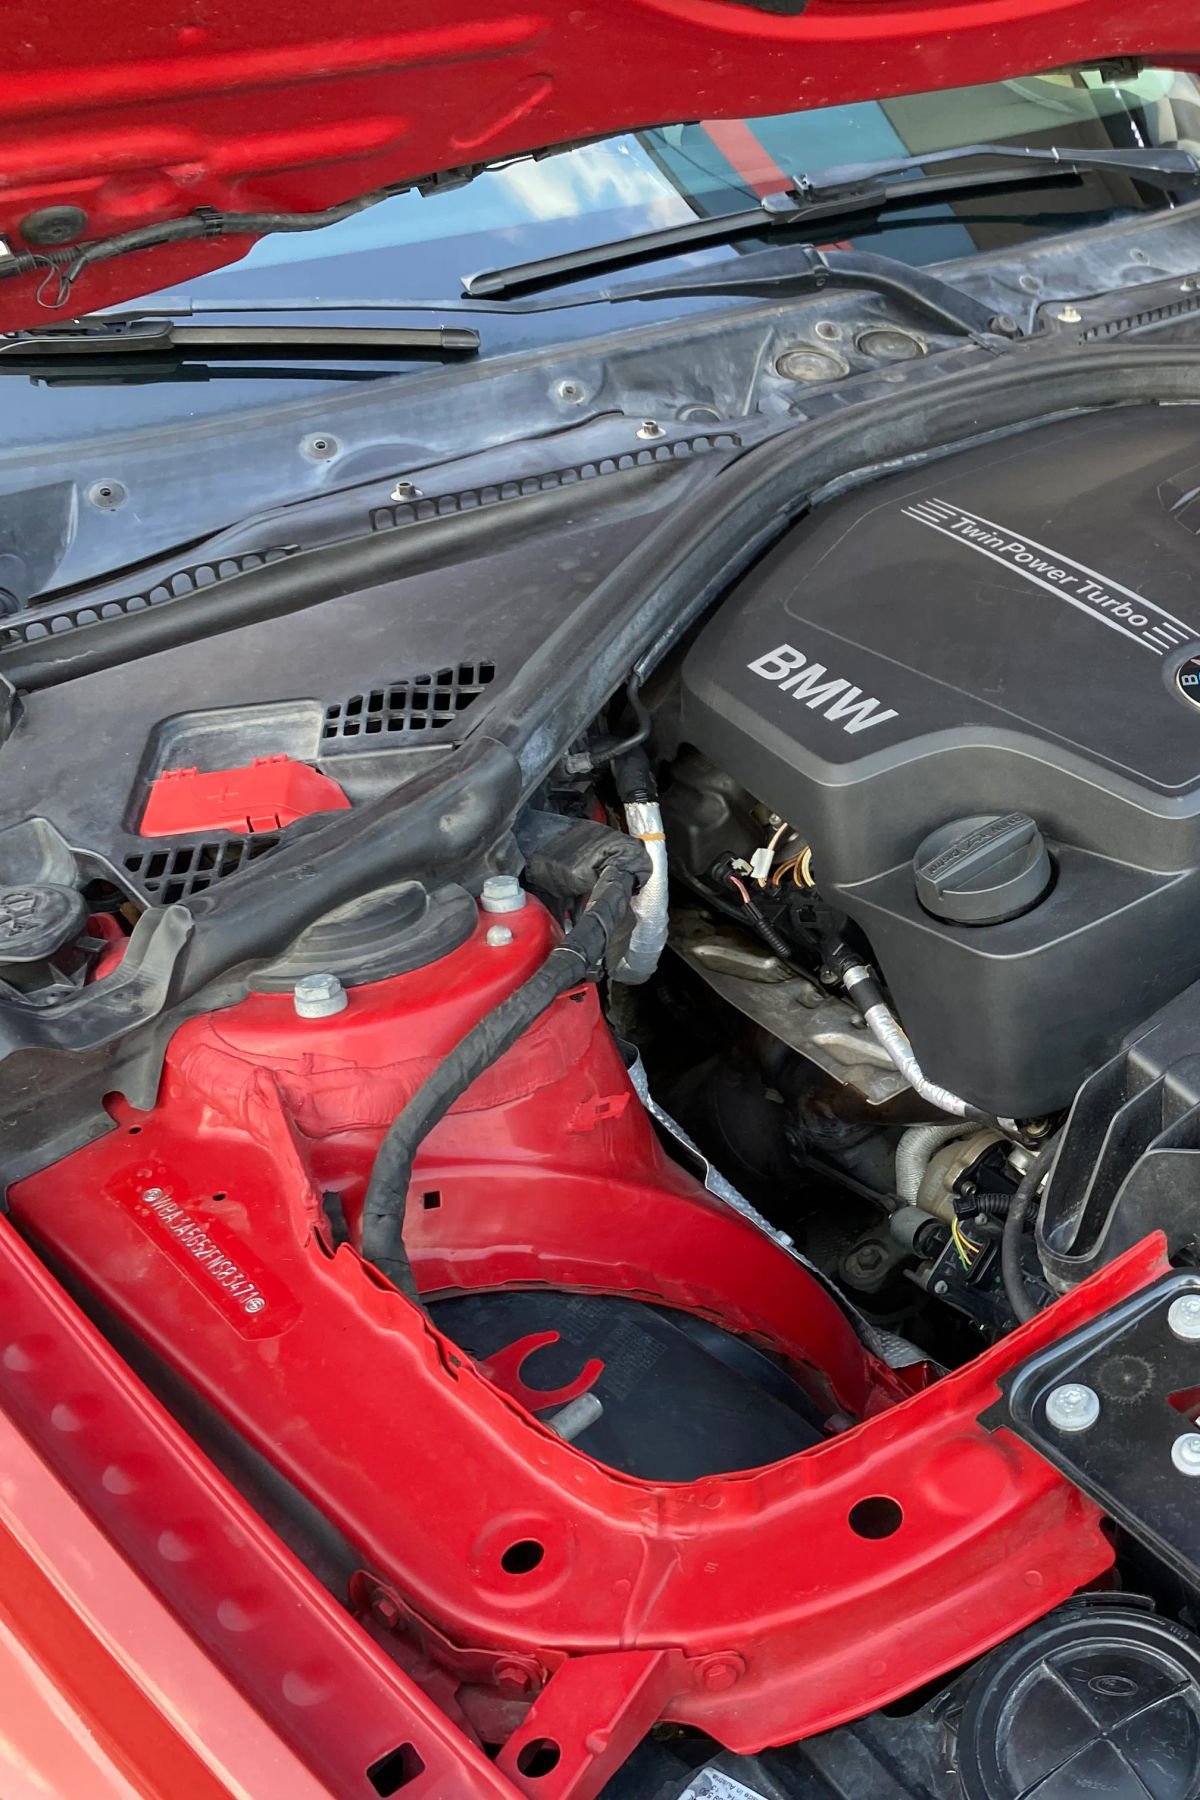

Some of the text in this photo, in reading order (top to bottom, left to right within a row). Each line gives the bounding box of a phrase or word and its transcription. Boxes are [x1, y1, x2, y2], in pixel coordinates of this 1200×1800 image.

[1076, 580, 1149, 627] Turbo
[746, 644, 898, 735] BMW
[929, 849, 960, 876] Castrol
[712, 1773, 737, 1790] Austria
